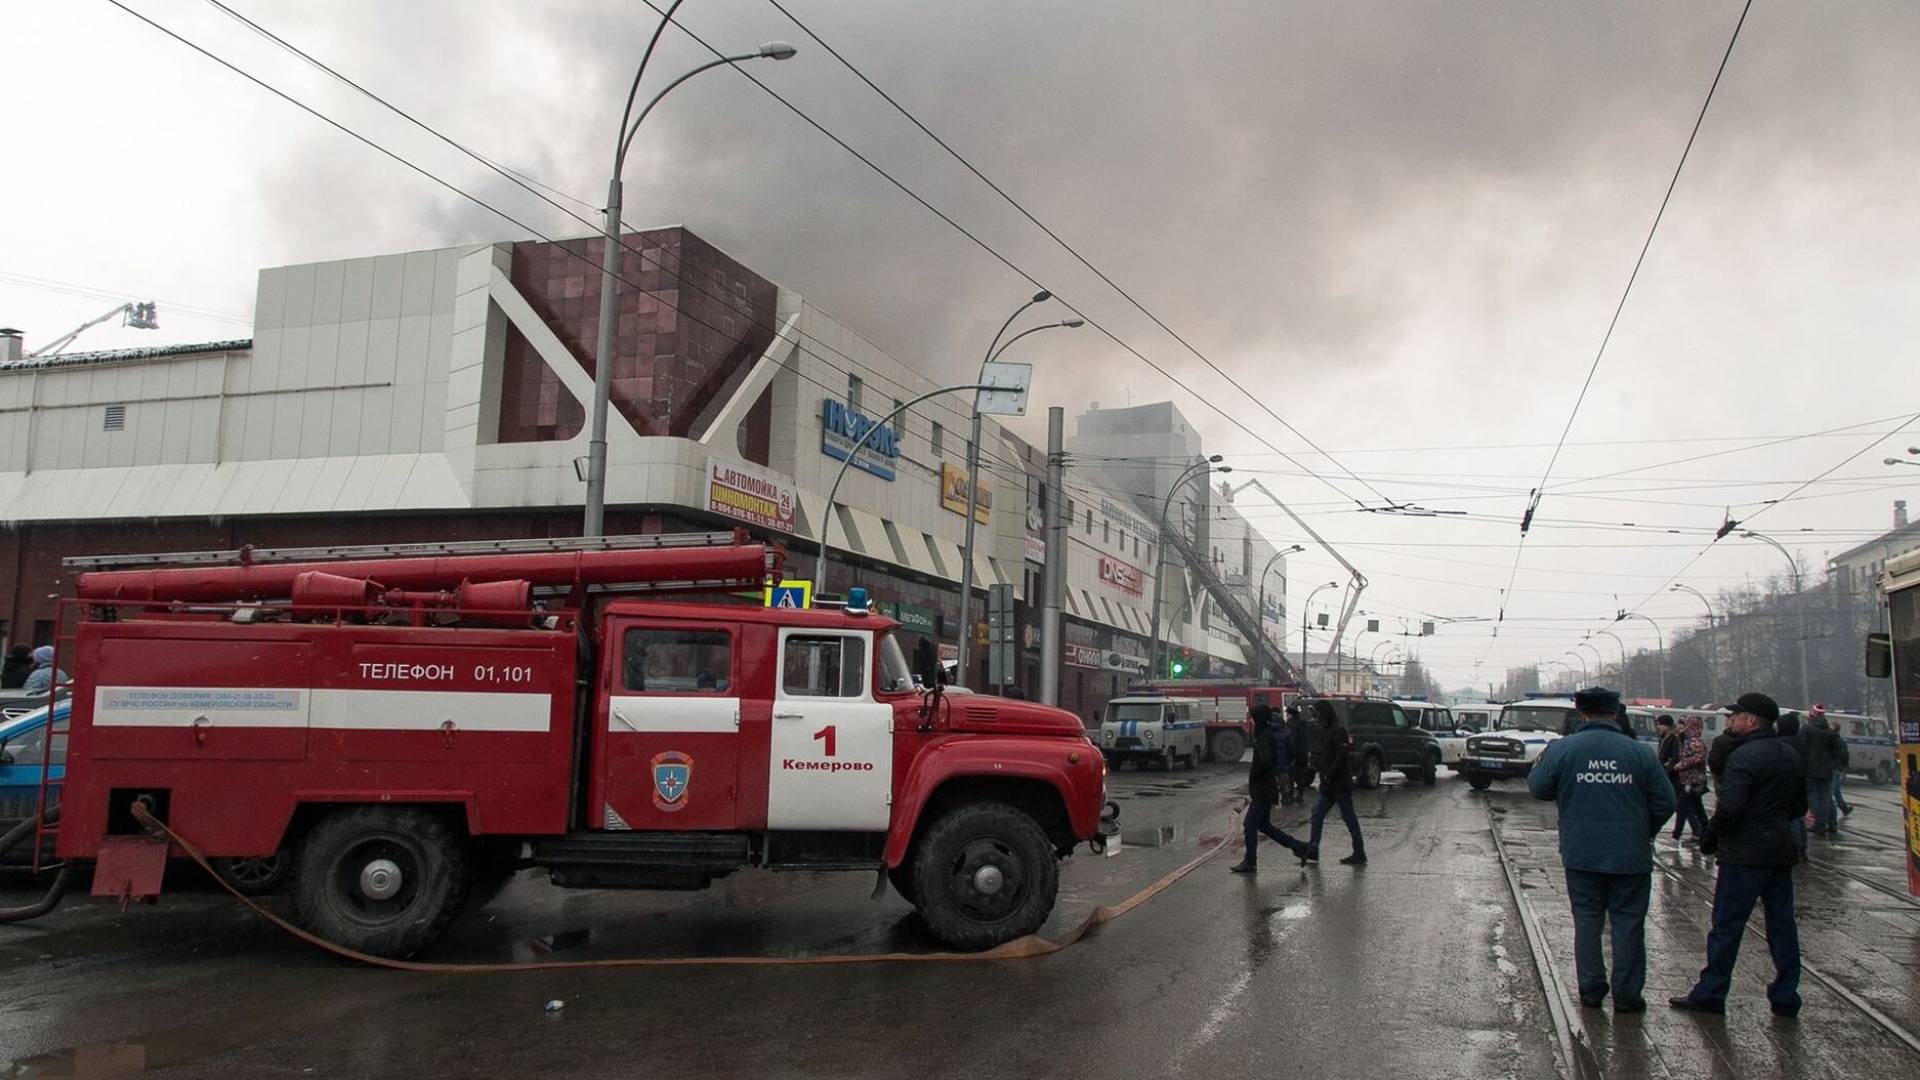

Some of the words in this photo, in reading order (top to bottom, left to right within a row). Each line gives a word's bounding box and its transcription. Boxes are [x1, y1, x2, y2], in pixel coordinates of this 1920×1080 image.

[724, 468, 778, 500] АВТОМОЙКА
[712, 484, 777, 518] ШИНОМОНТАЖ
[781, 494, 790, 509] 24
[1103, 559, 1125, 583] DNS
[359, 664, 454, 681] ТЕЛЕФОН
[474, 665, 533, 684] 01,101
[814, 725, 836, 756] 1
[782, 759, 873, 773] Кемерово
[1588, 759, 1618, 770] МЧС
[1576, 773, 1634, 785] РОССИИ
